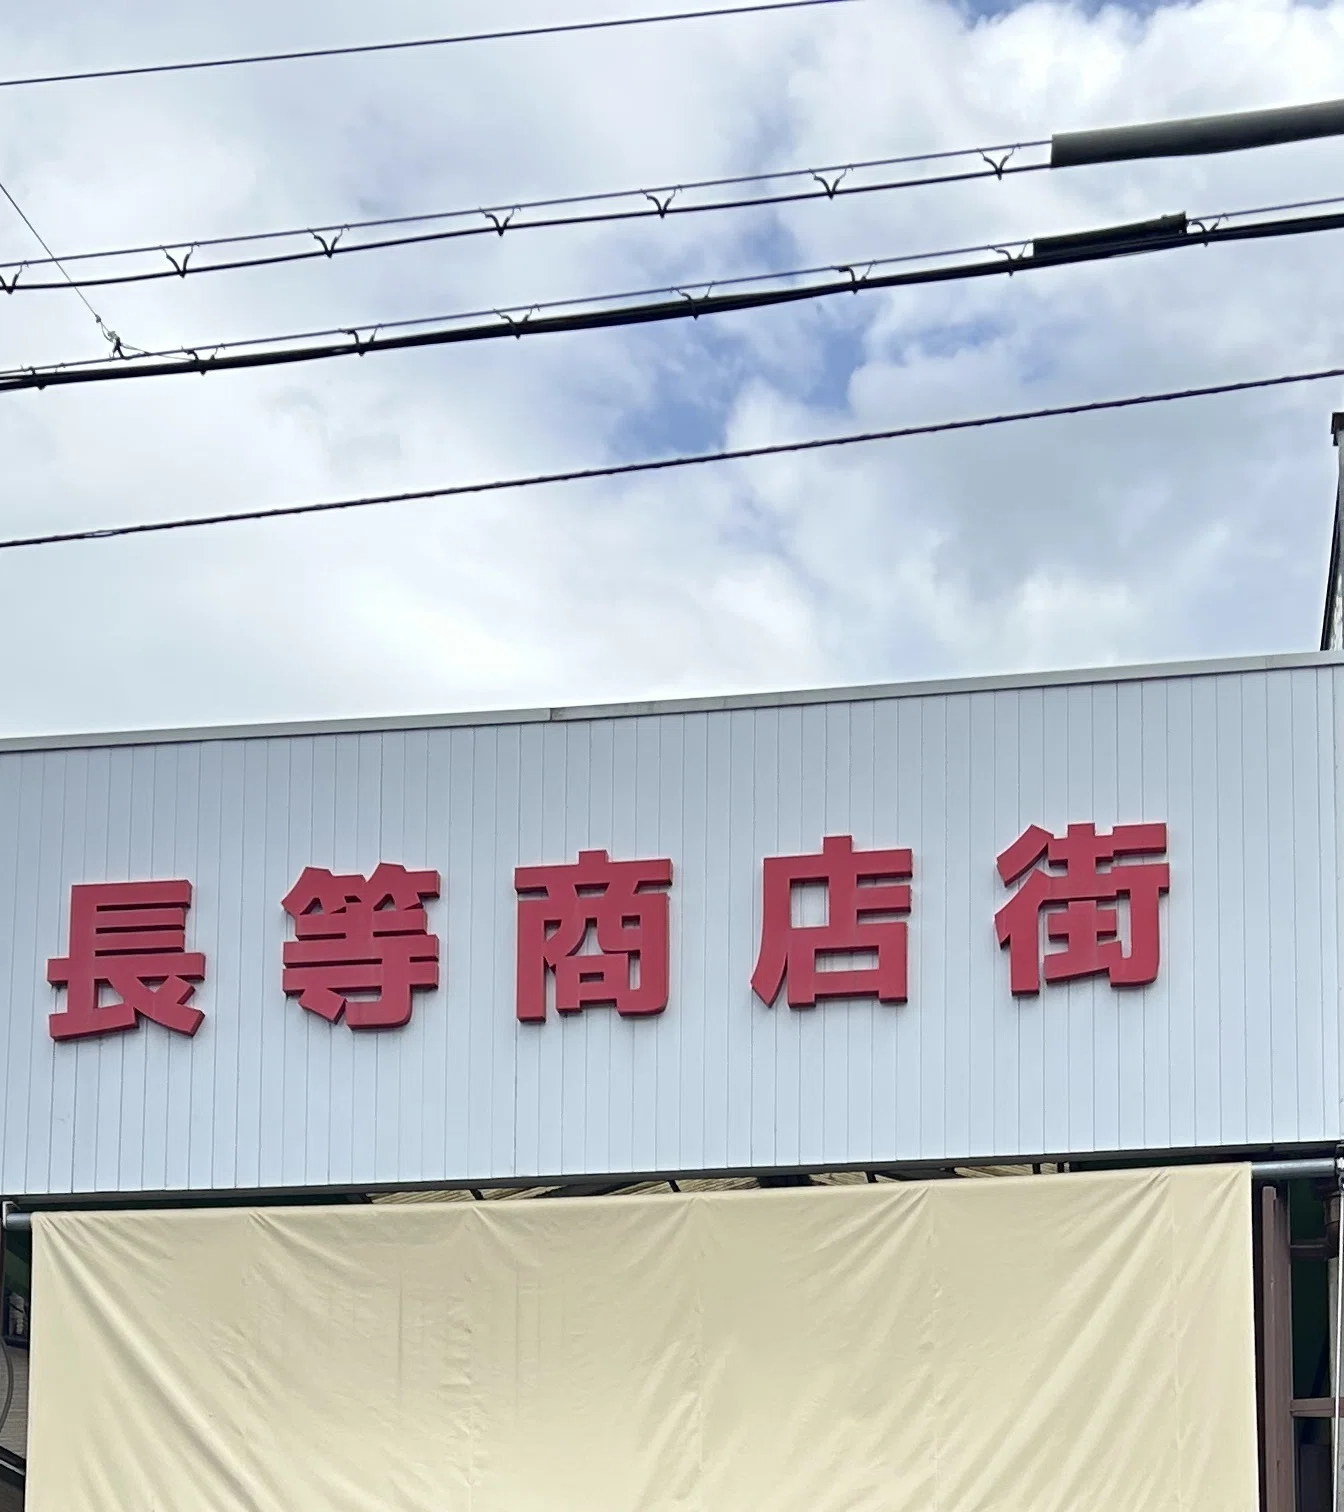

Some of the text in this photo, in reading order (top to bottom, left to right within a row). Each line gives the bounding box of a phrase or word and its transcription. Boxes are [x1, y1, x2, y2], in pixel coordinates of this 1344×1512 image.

[47, 821, 1171, 1041] 長等商店街
